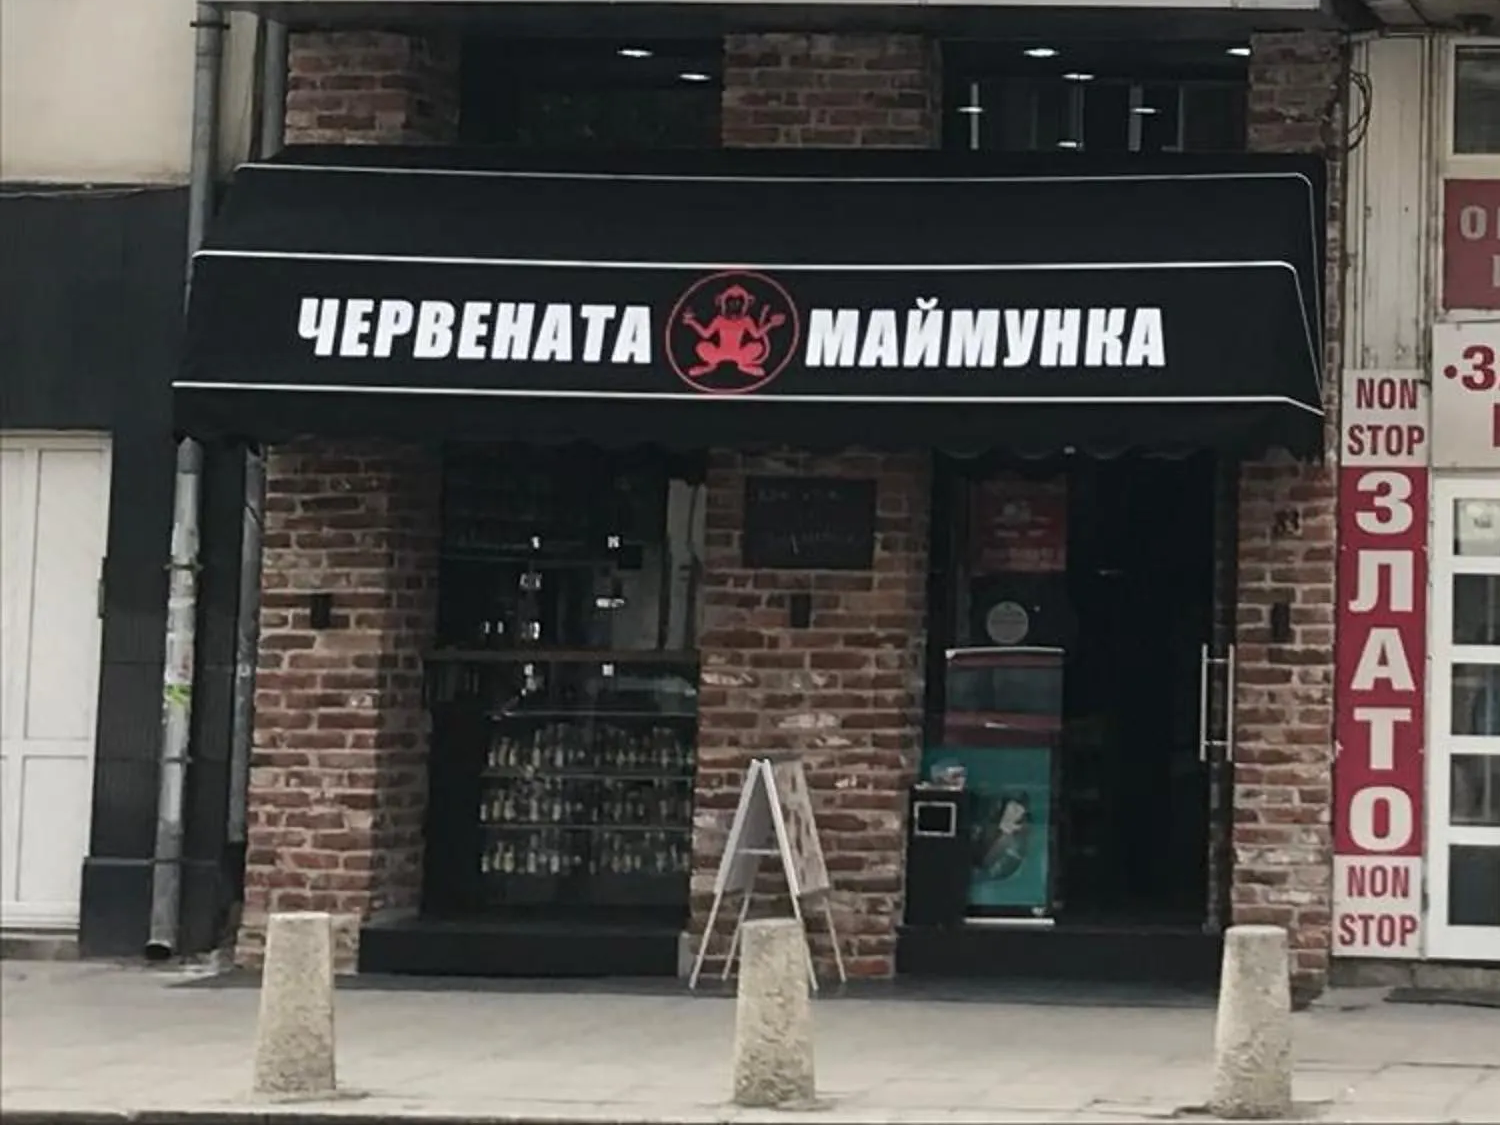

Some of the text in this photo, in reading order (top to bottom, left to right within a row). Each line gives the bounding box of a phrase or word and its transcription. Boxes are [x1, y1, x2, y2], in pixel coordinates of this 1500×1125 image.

[298, 297, 1166, 367] ЧЕРВЕНАТА МАЙМУНКА
[1356, 377, 1418, 410] NON
[1347, 423, 1425, 456] STOP
[1348, 470, 1416, 852] ЗЛАТО
[1347, 864, 1410, 897] NON
[1339, 913, 1418, 947] STOP
